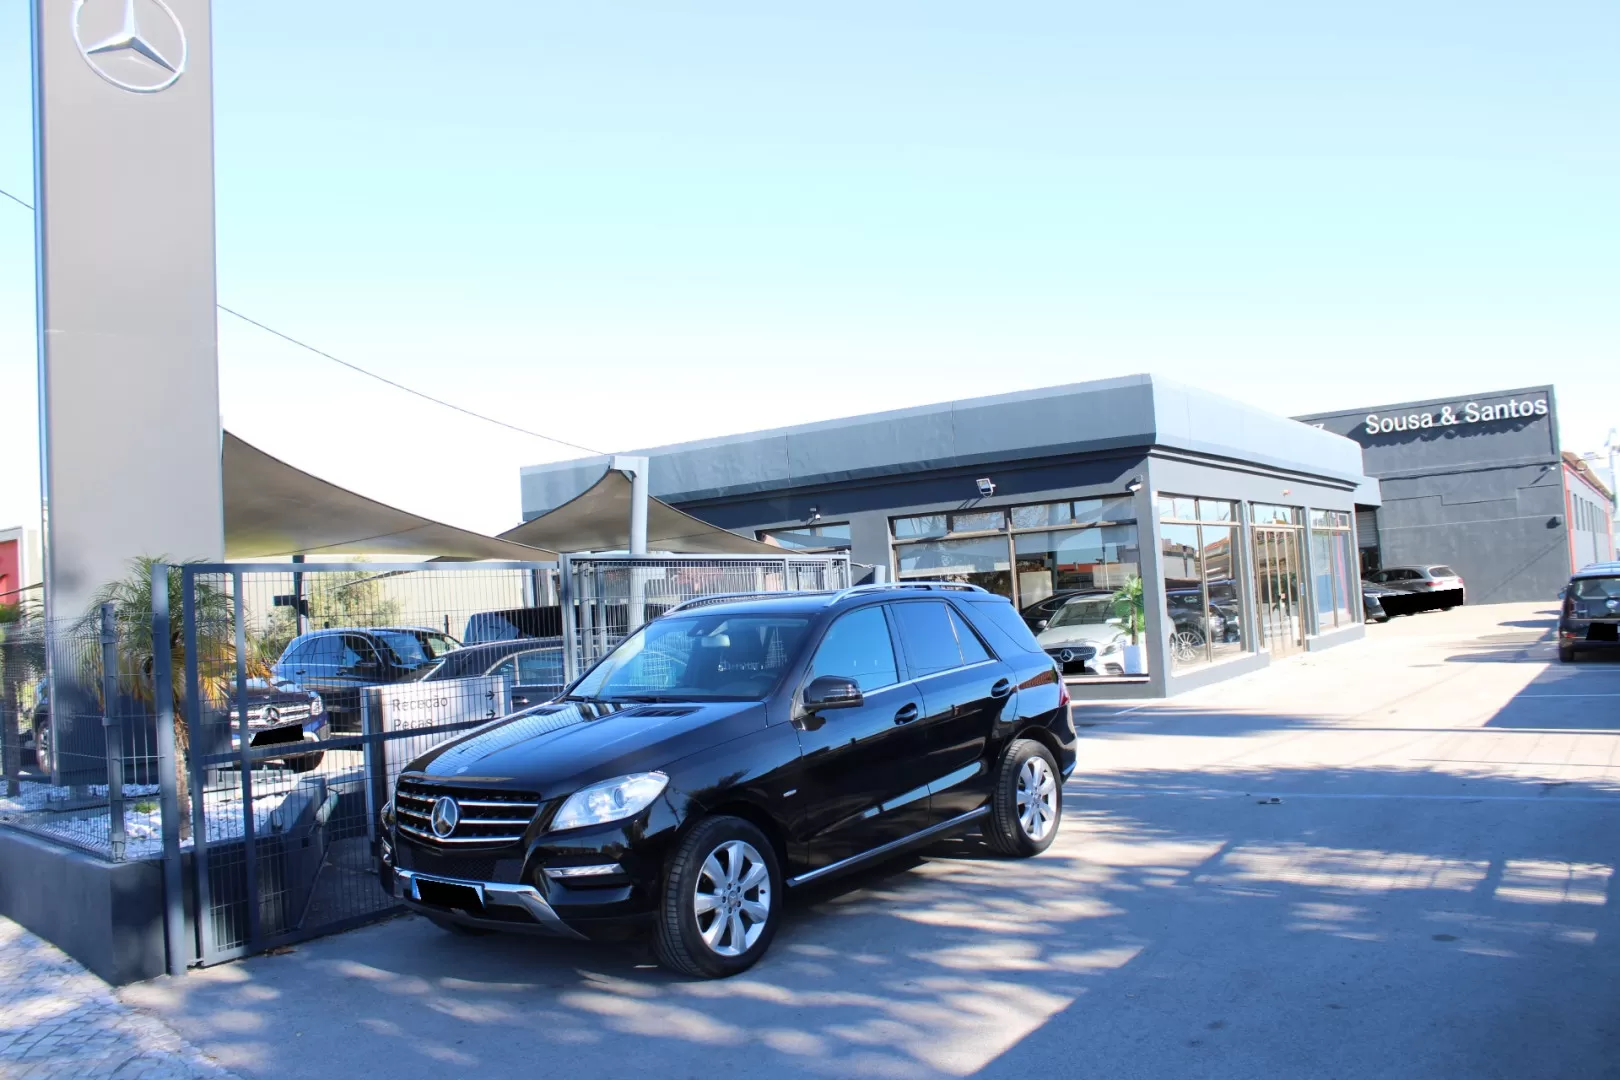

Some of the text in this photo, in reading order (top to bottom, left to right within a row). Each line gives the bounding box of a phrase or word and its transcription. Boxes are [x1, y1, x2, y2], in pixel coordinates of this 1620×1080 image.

[1365, 398, 1549, 435] Sousa & Santos
